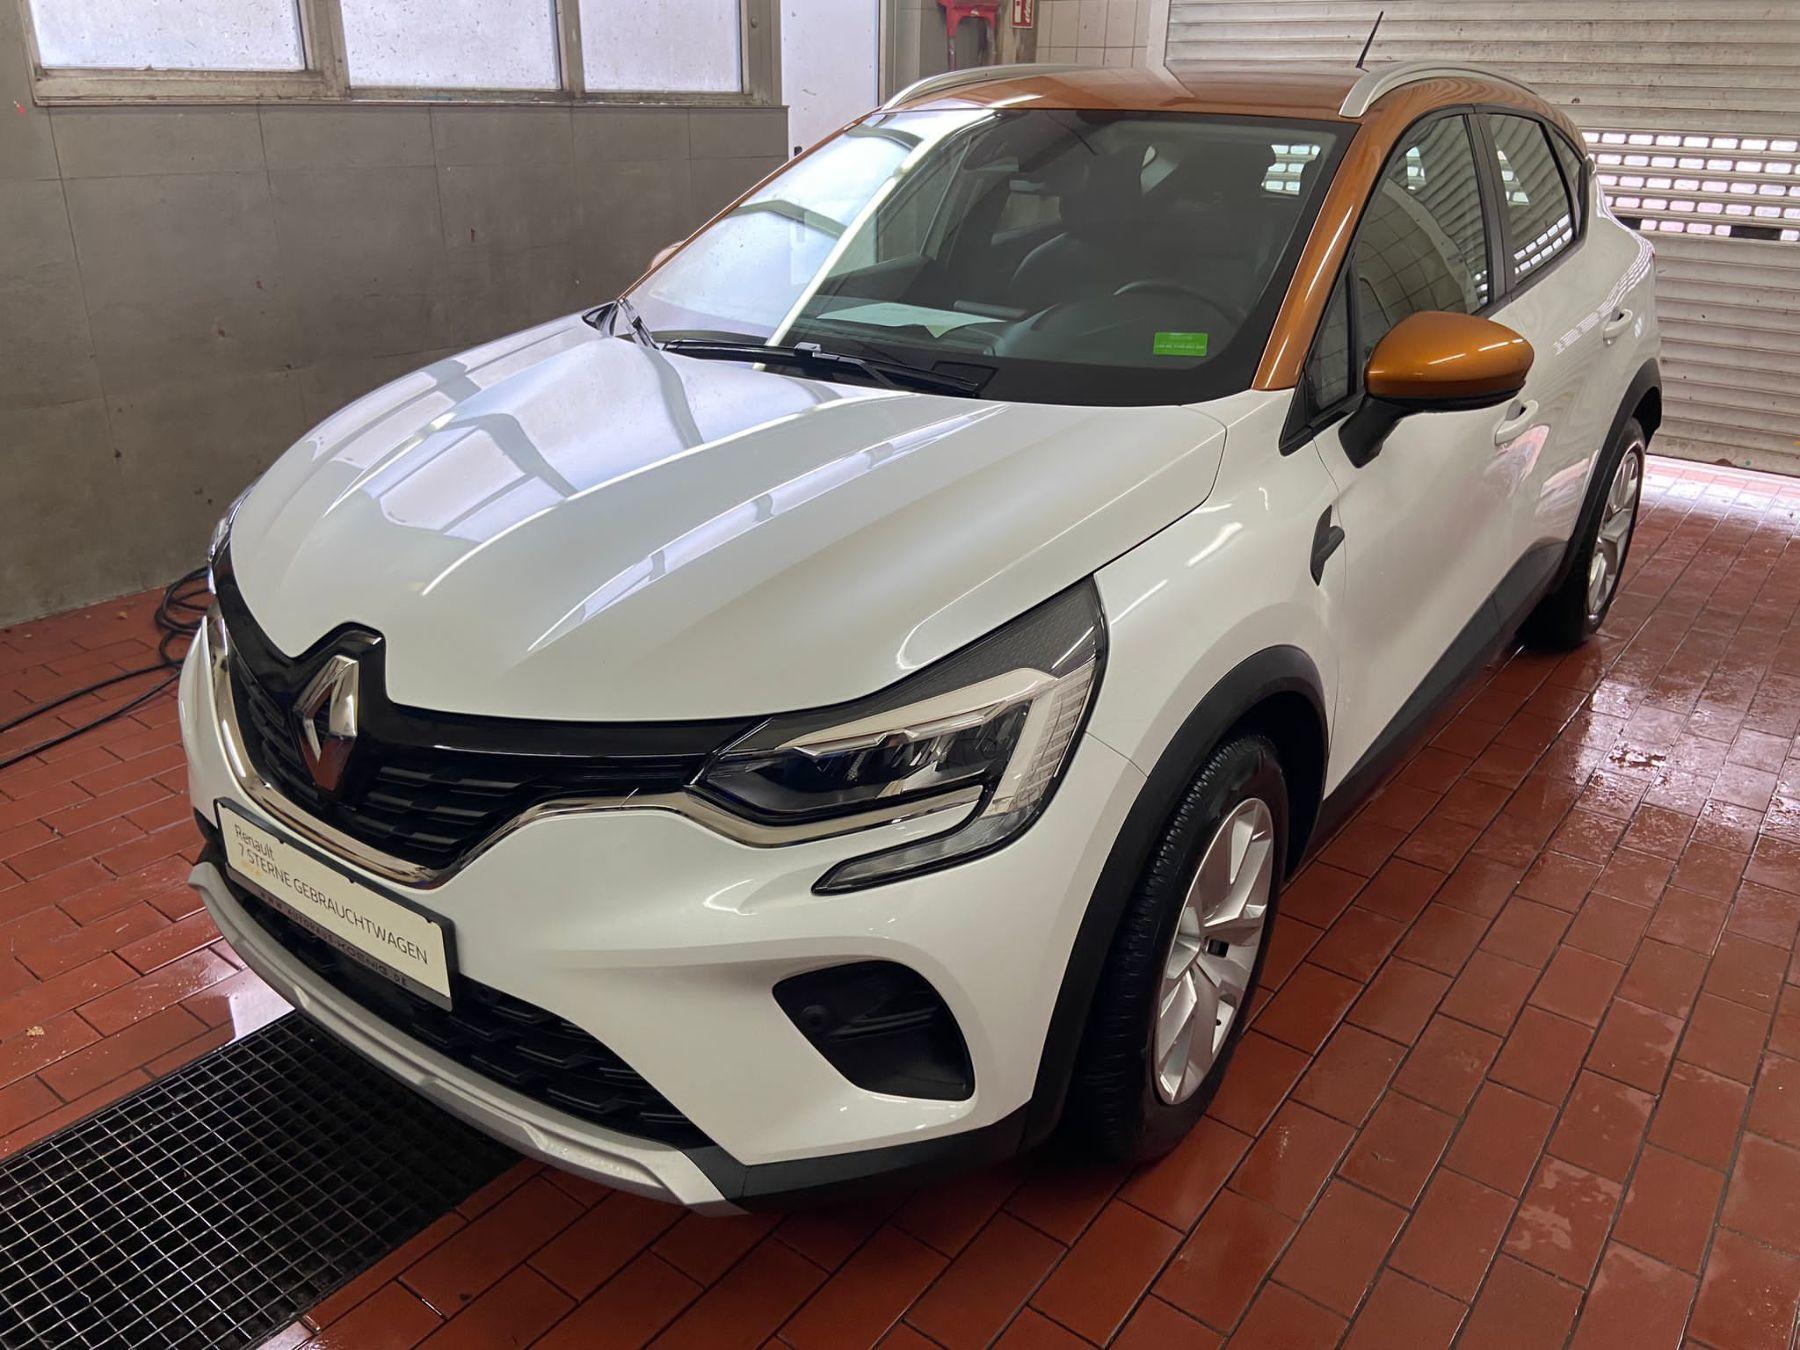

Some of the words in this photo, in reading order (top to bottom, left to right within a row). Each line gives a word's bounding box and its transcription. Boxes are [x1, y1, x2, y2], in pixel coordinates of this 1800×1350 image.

[234, 823, 275, 860] Renault
[238, 842, 245, 858] 7
[246, 848, 293, 888] STERNE
[293, 878, 428, 965] GEBRAUCHTWAGEN
